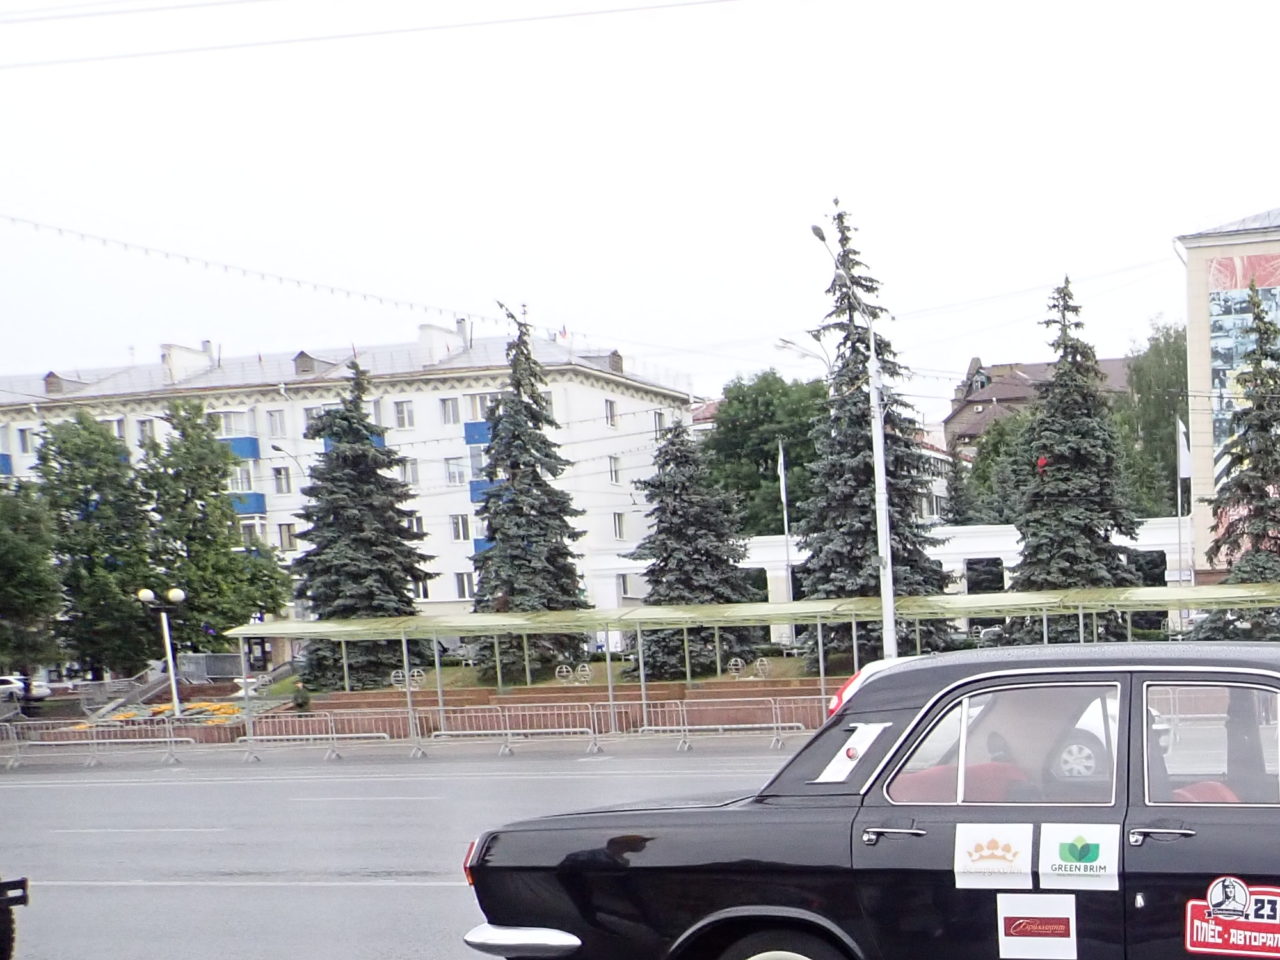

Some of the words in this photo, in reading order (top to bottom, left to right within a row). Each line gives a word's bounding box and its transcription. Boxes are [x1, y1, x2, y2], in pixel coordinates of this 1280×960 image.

[1050, 863, 1082, 873] GREEN
[1083, 864, 1107, 874] BRIM
[1254, 898, 1278, 920] 23
[1193, 919, 1223, 943] ПЛЁС
